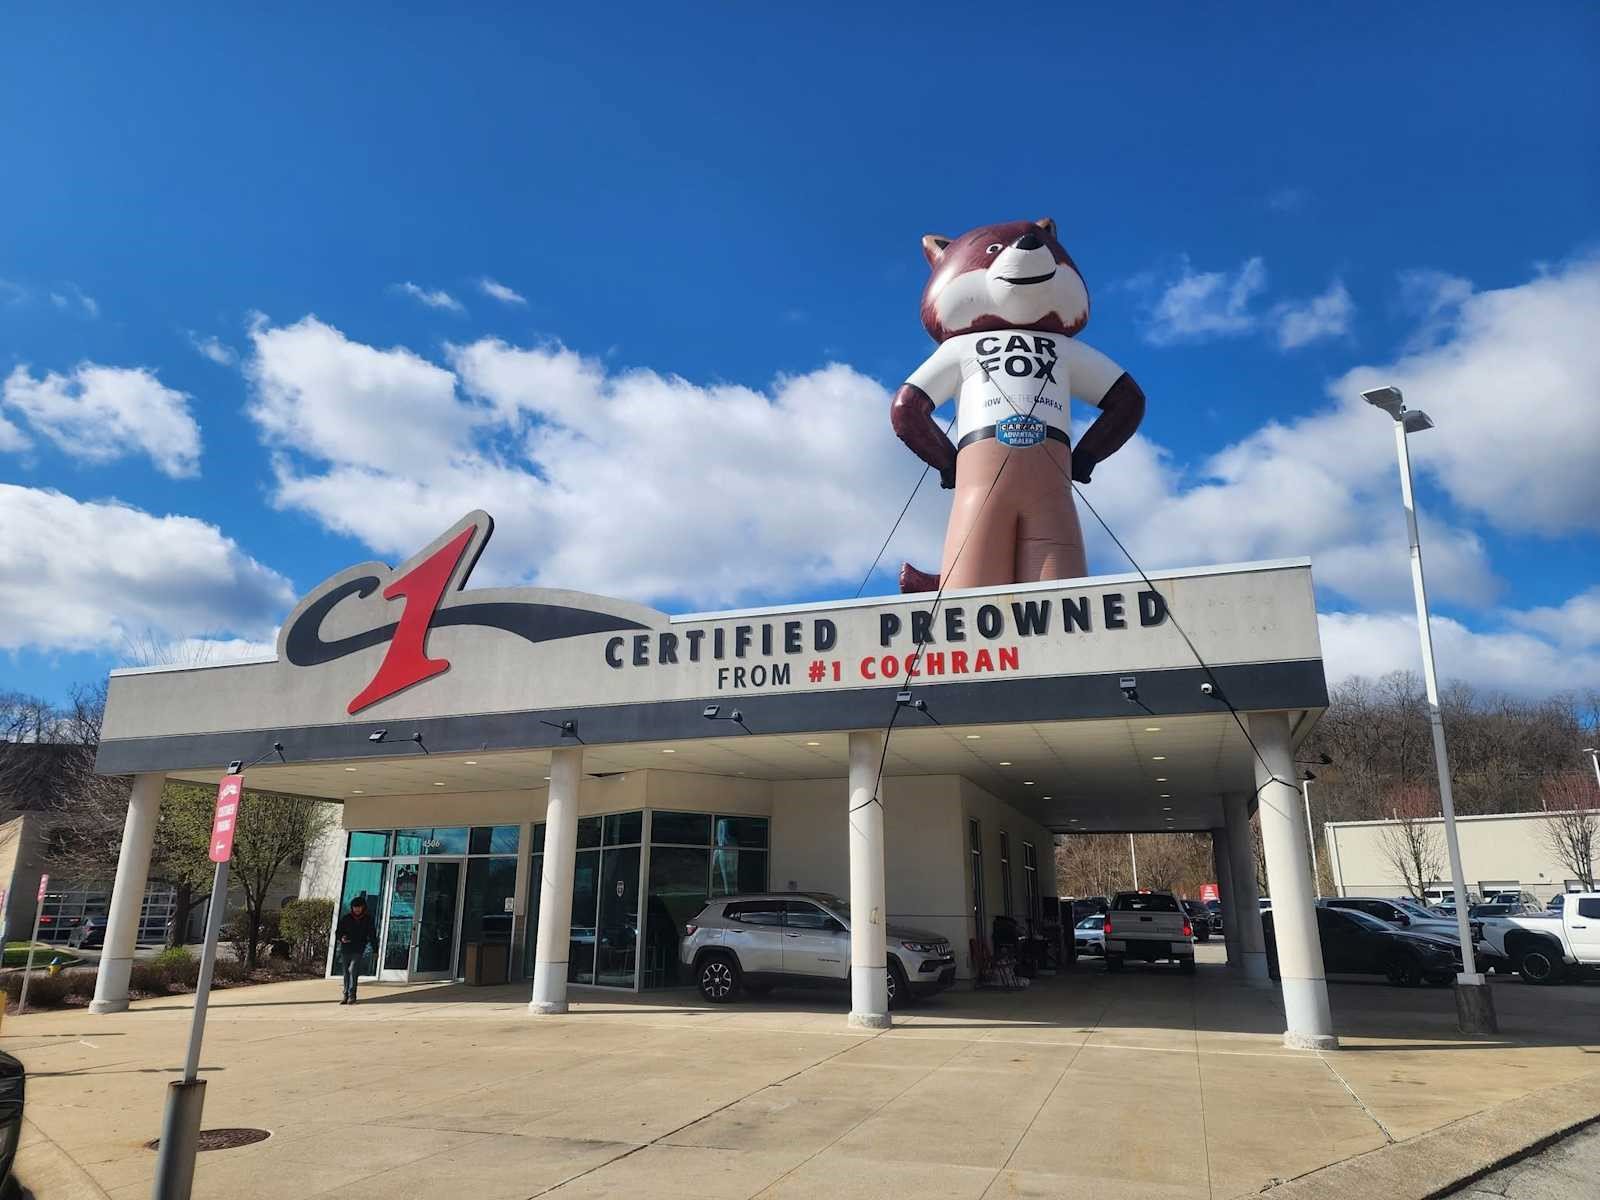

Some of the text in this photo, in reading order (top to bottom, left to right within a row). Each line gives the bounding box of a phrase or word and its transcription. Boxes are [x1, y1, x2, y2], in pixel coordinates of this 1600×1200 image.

[976, 335, 1057, 359] CAR
[979, 355, 1057, 385] FOX
[605, 590, 1170, 669] CERTIFIED PREOWNED
[718, 646, 1020, 690] FROM #1 COCHRAN
